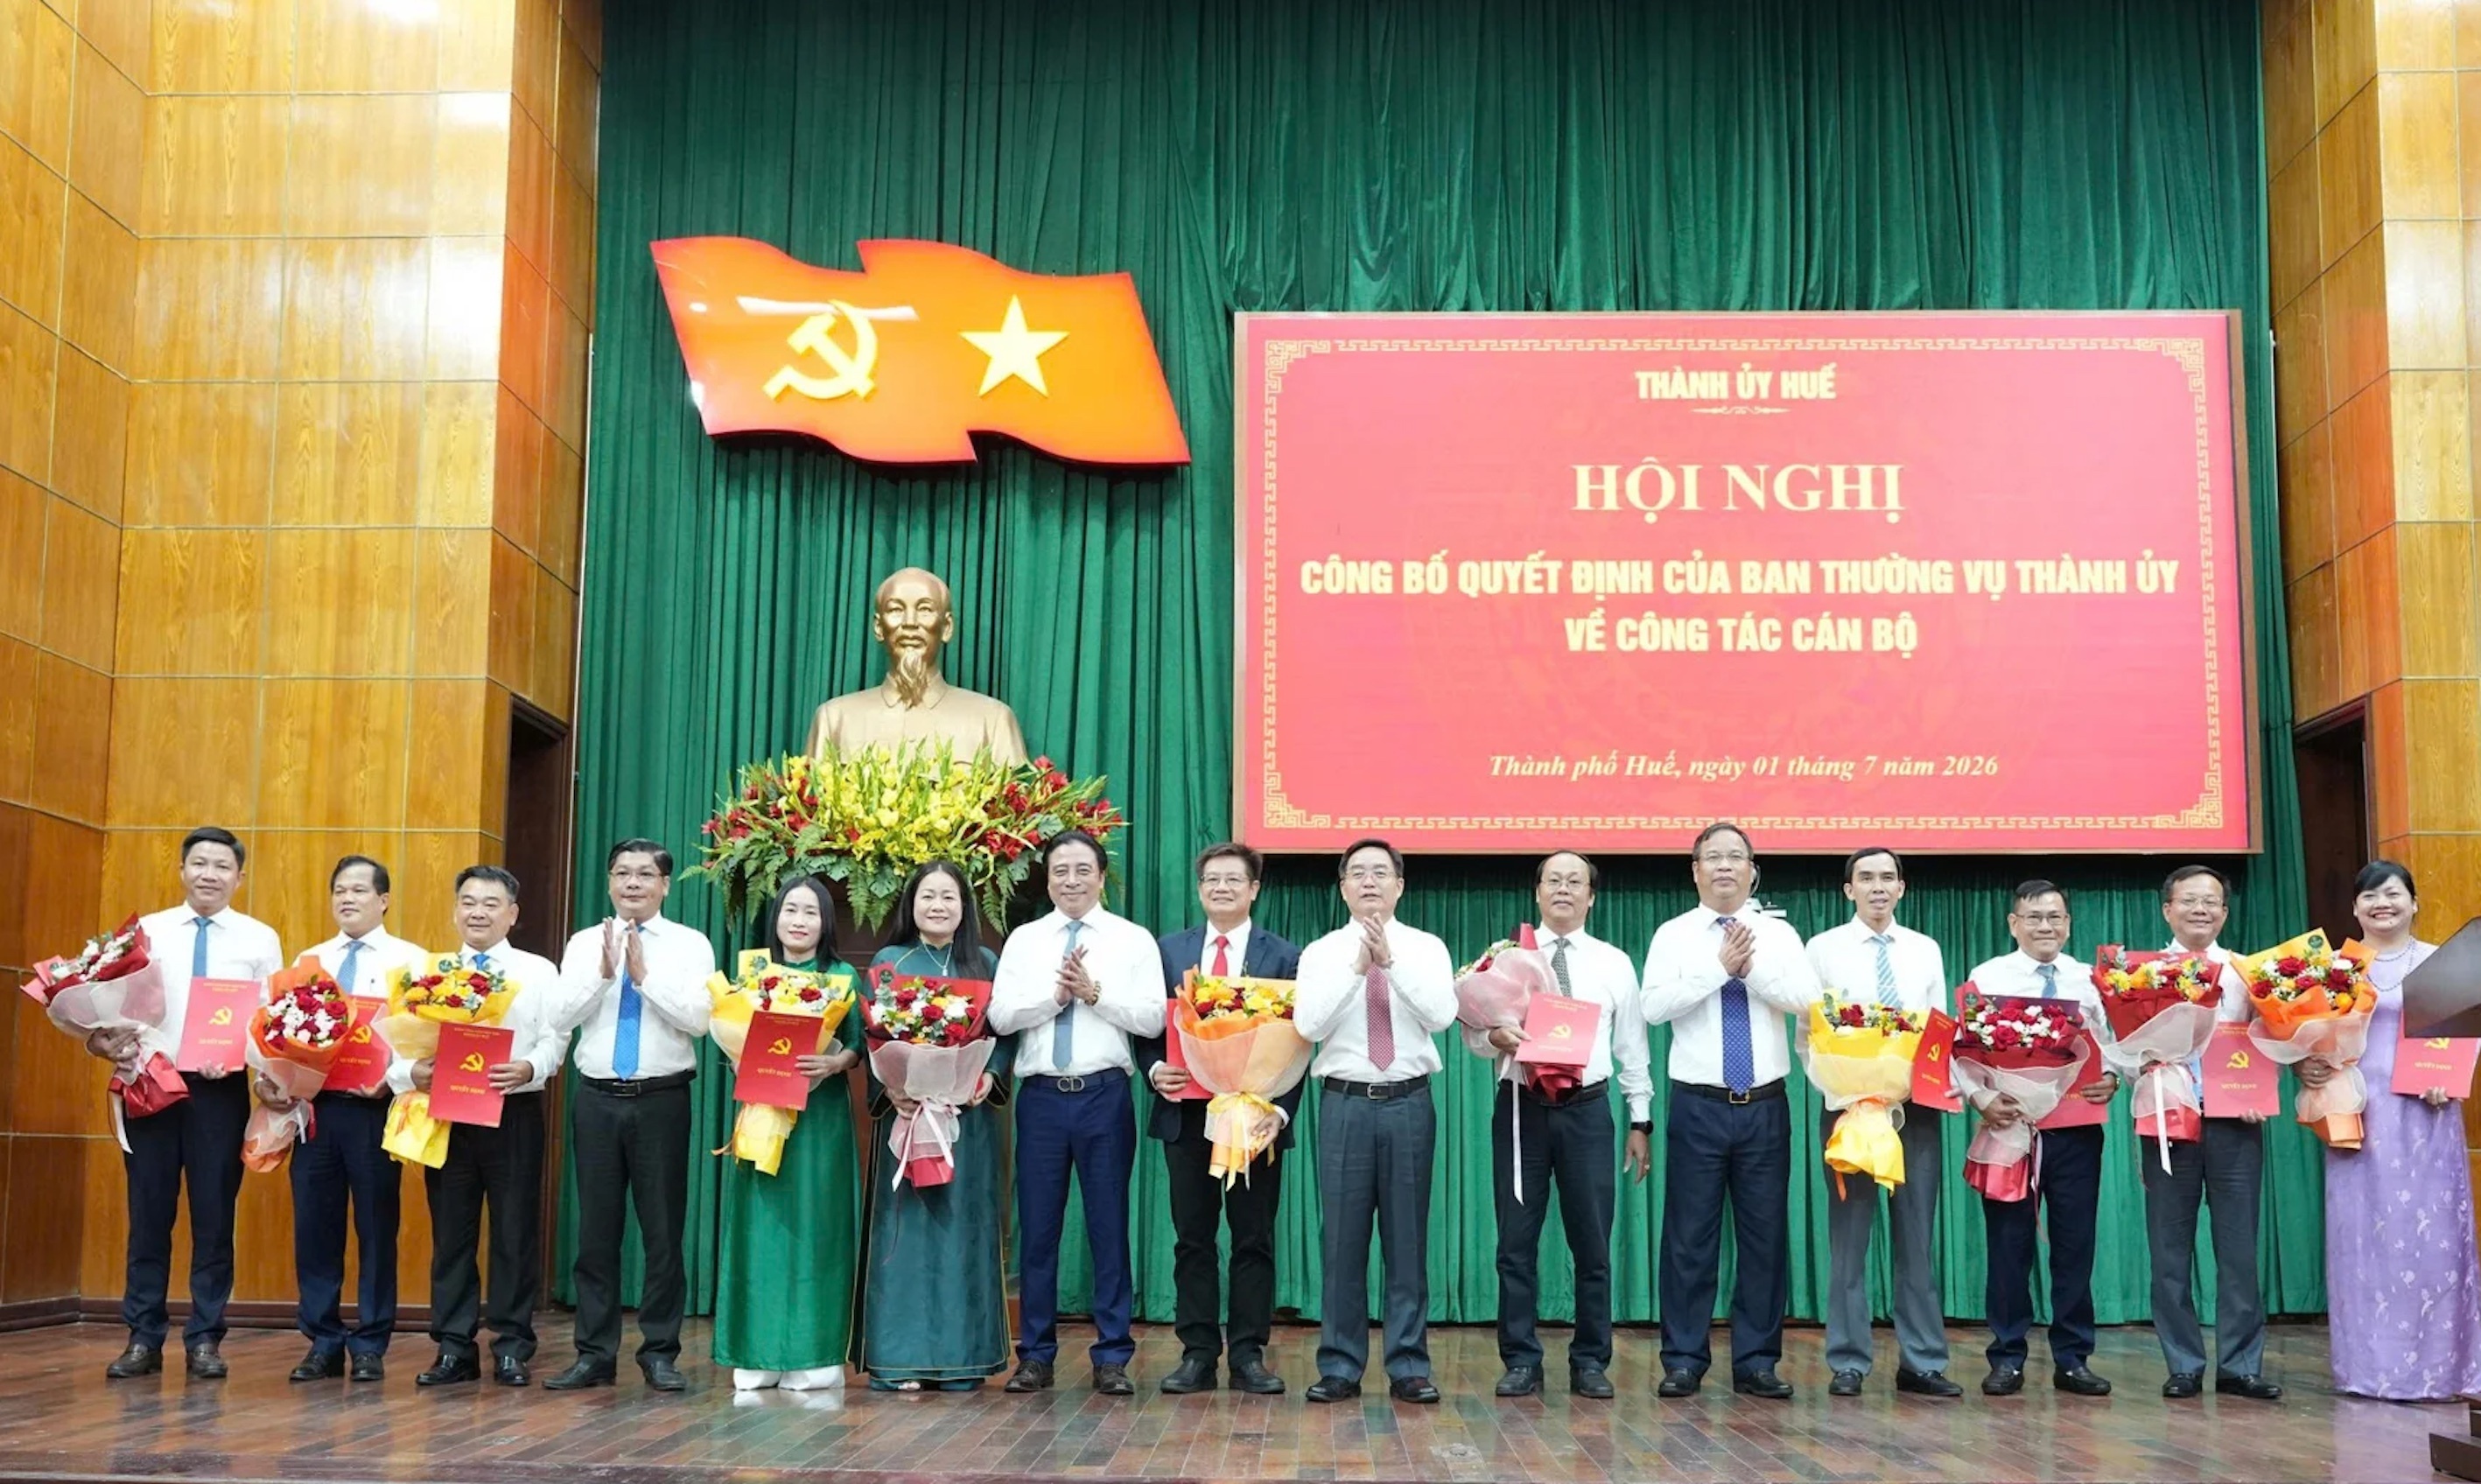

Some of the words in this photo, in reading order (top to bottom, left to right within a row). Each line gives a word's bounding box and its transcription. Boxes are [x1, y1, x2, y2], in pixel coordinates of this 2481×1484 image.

[1635, 366, 1728, 399] THÀNH
[1736, 362, 1773, 399] ỦY
[1780, 362, 1837, 399] HUẾ
[1573, 456, 1701, 523] HỘI
[1721, 465, 1904, 523] NGHỊ
[1300, 554, 1393, 594] CÔNG
[1403, 549, 1448, 594] BỐ
[1458, 550, 1563, 598] QUYẾT
[1570, 560, 1653, 601] ĐỊNH
[1663, 549, 1732, 594] CỦA
[1740, 560, 1812, 594] BAN
[1819, 551, 1954, 594] THƯỜNG
[1962, 559, 2008, 601] VỤ
[2014, 552, 2127, 594] THÀNH
[2135, 549, 2180, 594] ỦY
[1564, 606, 1607, 652] VỀ
[1615, 611, 1709, 652] CÔNG
[1716, 611, 1782, 652] TÁC
[1791, 611, 1863, 652] CÁN
[1871, 611, 1918, 659] BỘ
[1490, 755, 1566, 776] Thành
[1571, 749, 1618, 781] phố
[1624, 750, 1682, 779] Huế,
[1688, 755, 1747, 781] ngày
[1752, 756, 1779, 776] 01
[1787, 755, 1856, 781] tháng
[1864, 755, 1878, 776] 7
[1882, 757, 1935, 776] năm
[1942, 755, 1999, 776] 2026
[1057, 1076, 1085, 1092] CD
